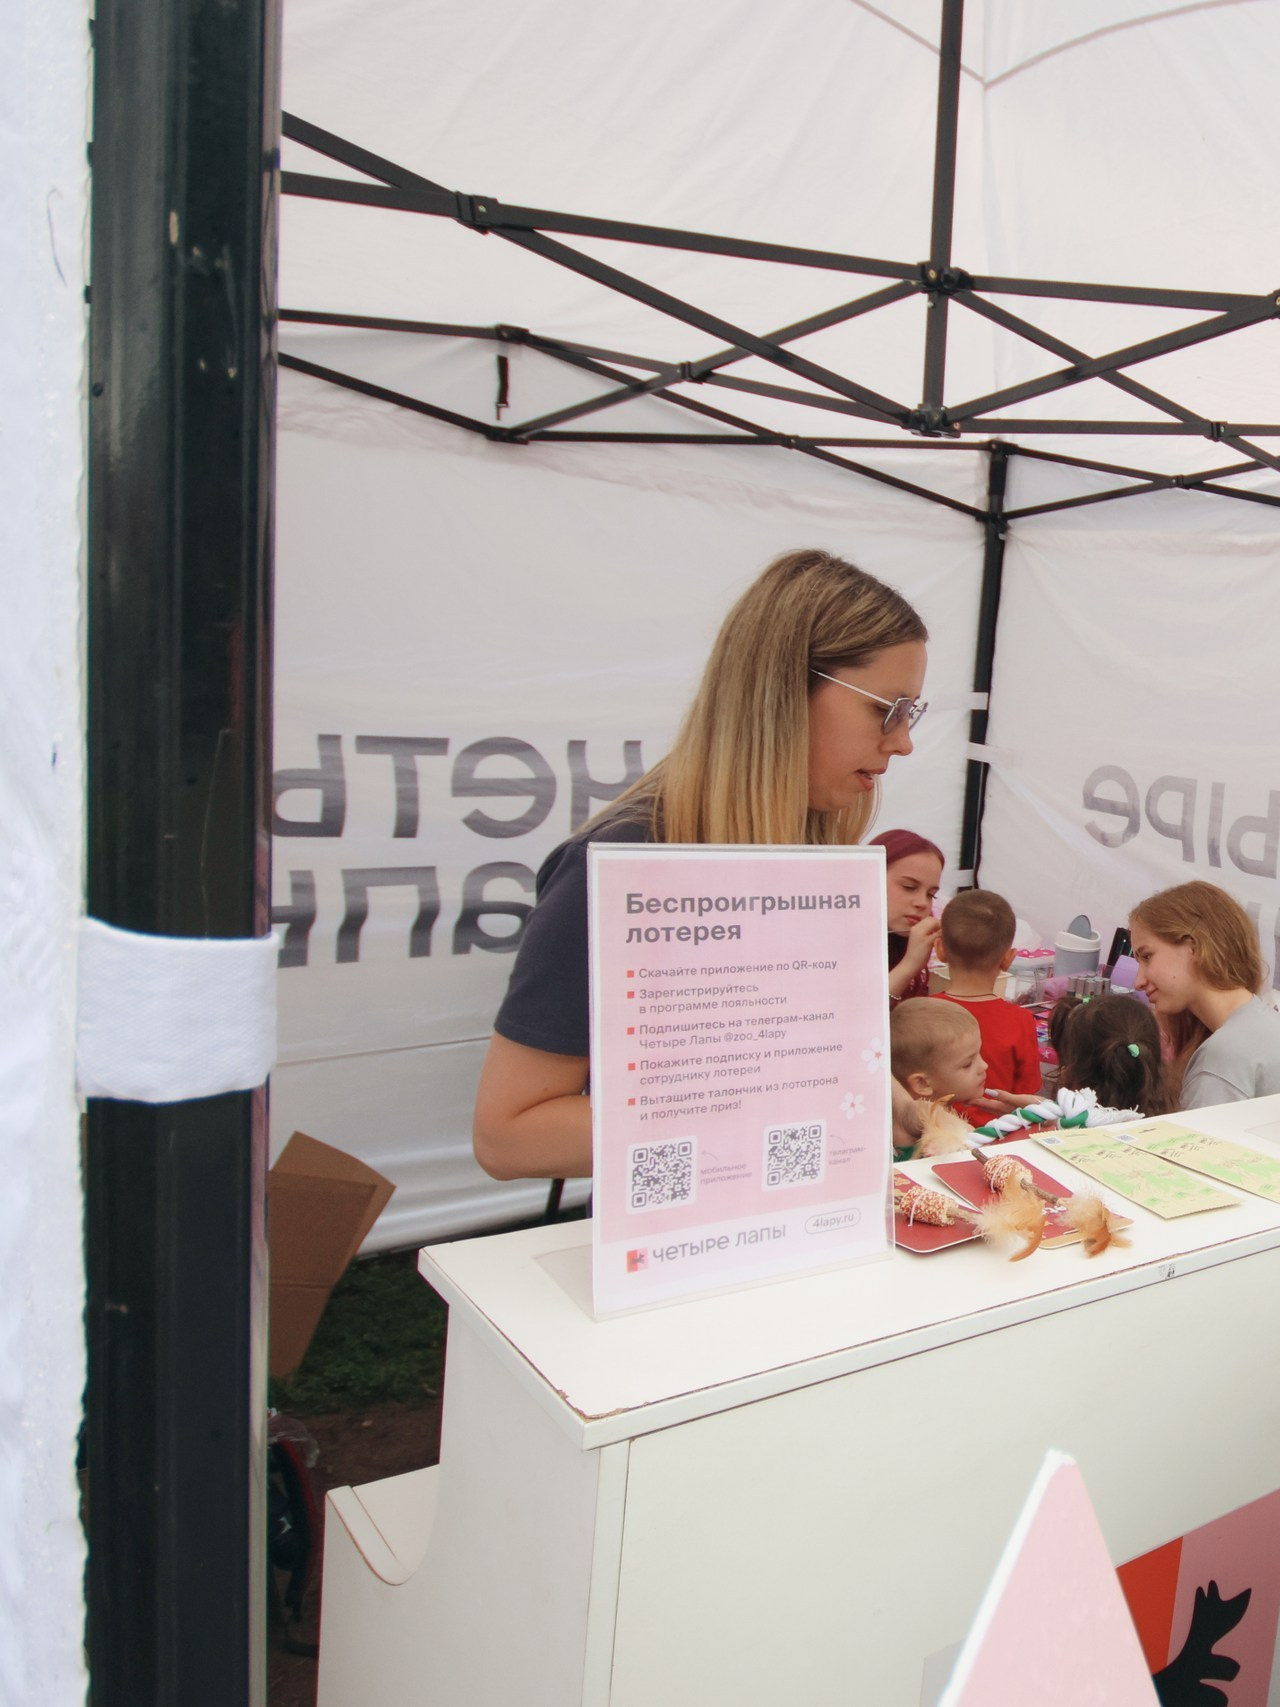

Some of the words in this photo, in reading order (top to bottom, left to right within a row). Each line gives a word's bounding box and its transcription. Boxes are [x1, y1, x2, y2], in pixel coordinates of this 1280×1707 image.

[626, 893, 861, 917] Беспроигрышная
[626, 924, 742, 946] лотерея
[639, 966, 697, 979] Скачайте
[700, 962, 774, 976] приложение
[776, 962, 790, 972] по
[792, 960, 838, 972] QR-коду
[639, 984, 759, 1001] Зарегистрируйтесь
[639, 1006, 647, 1015] в
[649, 1001, 718, 1015] программе
[721, 996, 787, 1010] лояльности
[639, 1021, 726, 1037] Подпишитесь
[728, 1019, 743, 1029] на
[746, 1012, 835, 1029] телеграм-канал
[640, 1035, 687, 1050] Четыре
[689, 1034, 722, 1046] Лапы
[724, 1029, 787, 1044] @zoo_4lapy
[640, 1056, 702, 1071] Покажите
[705, 1050, 761, 1065] подписку
[764, 1050, 771, 1059] и
[774, 1043, 843, 1060] приложение
[640, 1071, 711, 1087] сотруднику
[713, 1064, 761, 1079] лотереи
[640, 1090, 705, 1106] Вытащите
[708, 1083, 763, 1099] талончик
[765, 1082, 780, 1092] из
[781, 1075, 839, 1091] лототрона
[640, 1112, 648, 1121] и
[651, 1104, 708, 1120] получите
[710, 1100, 742, 1113] приз!
[812, 1212, 854, 1229] 4lapy.ru
[652, 1234, 730, 1262] четыре
[735, 1223, 786, 1248] лапы
